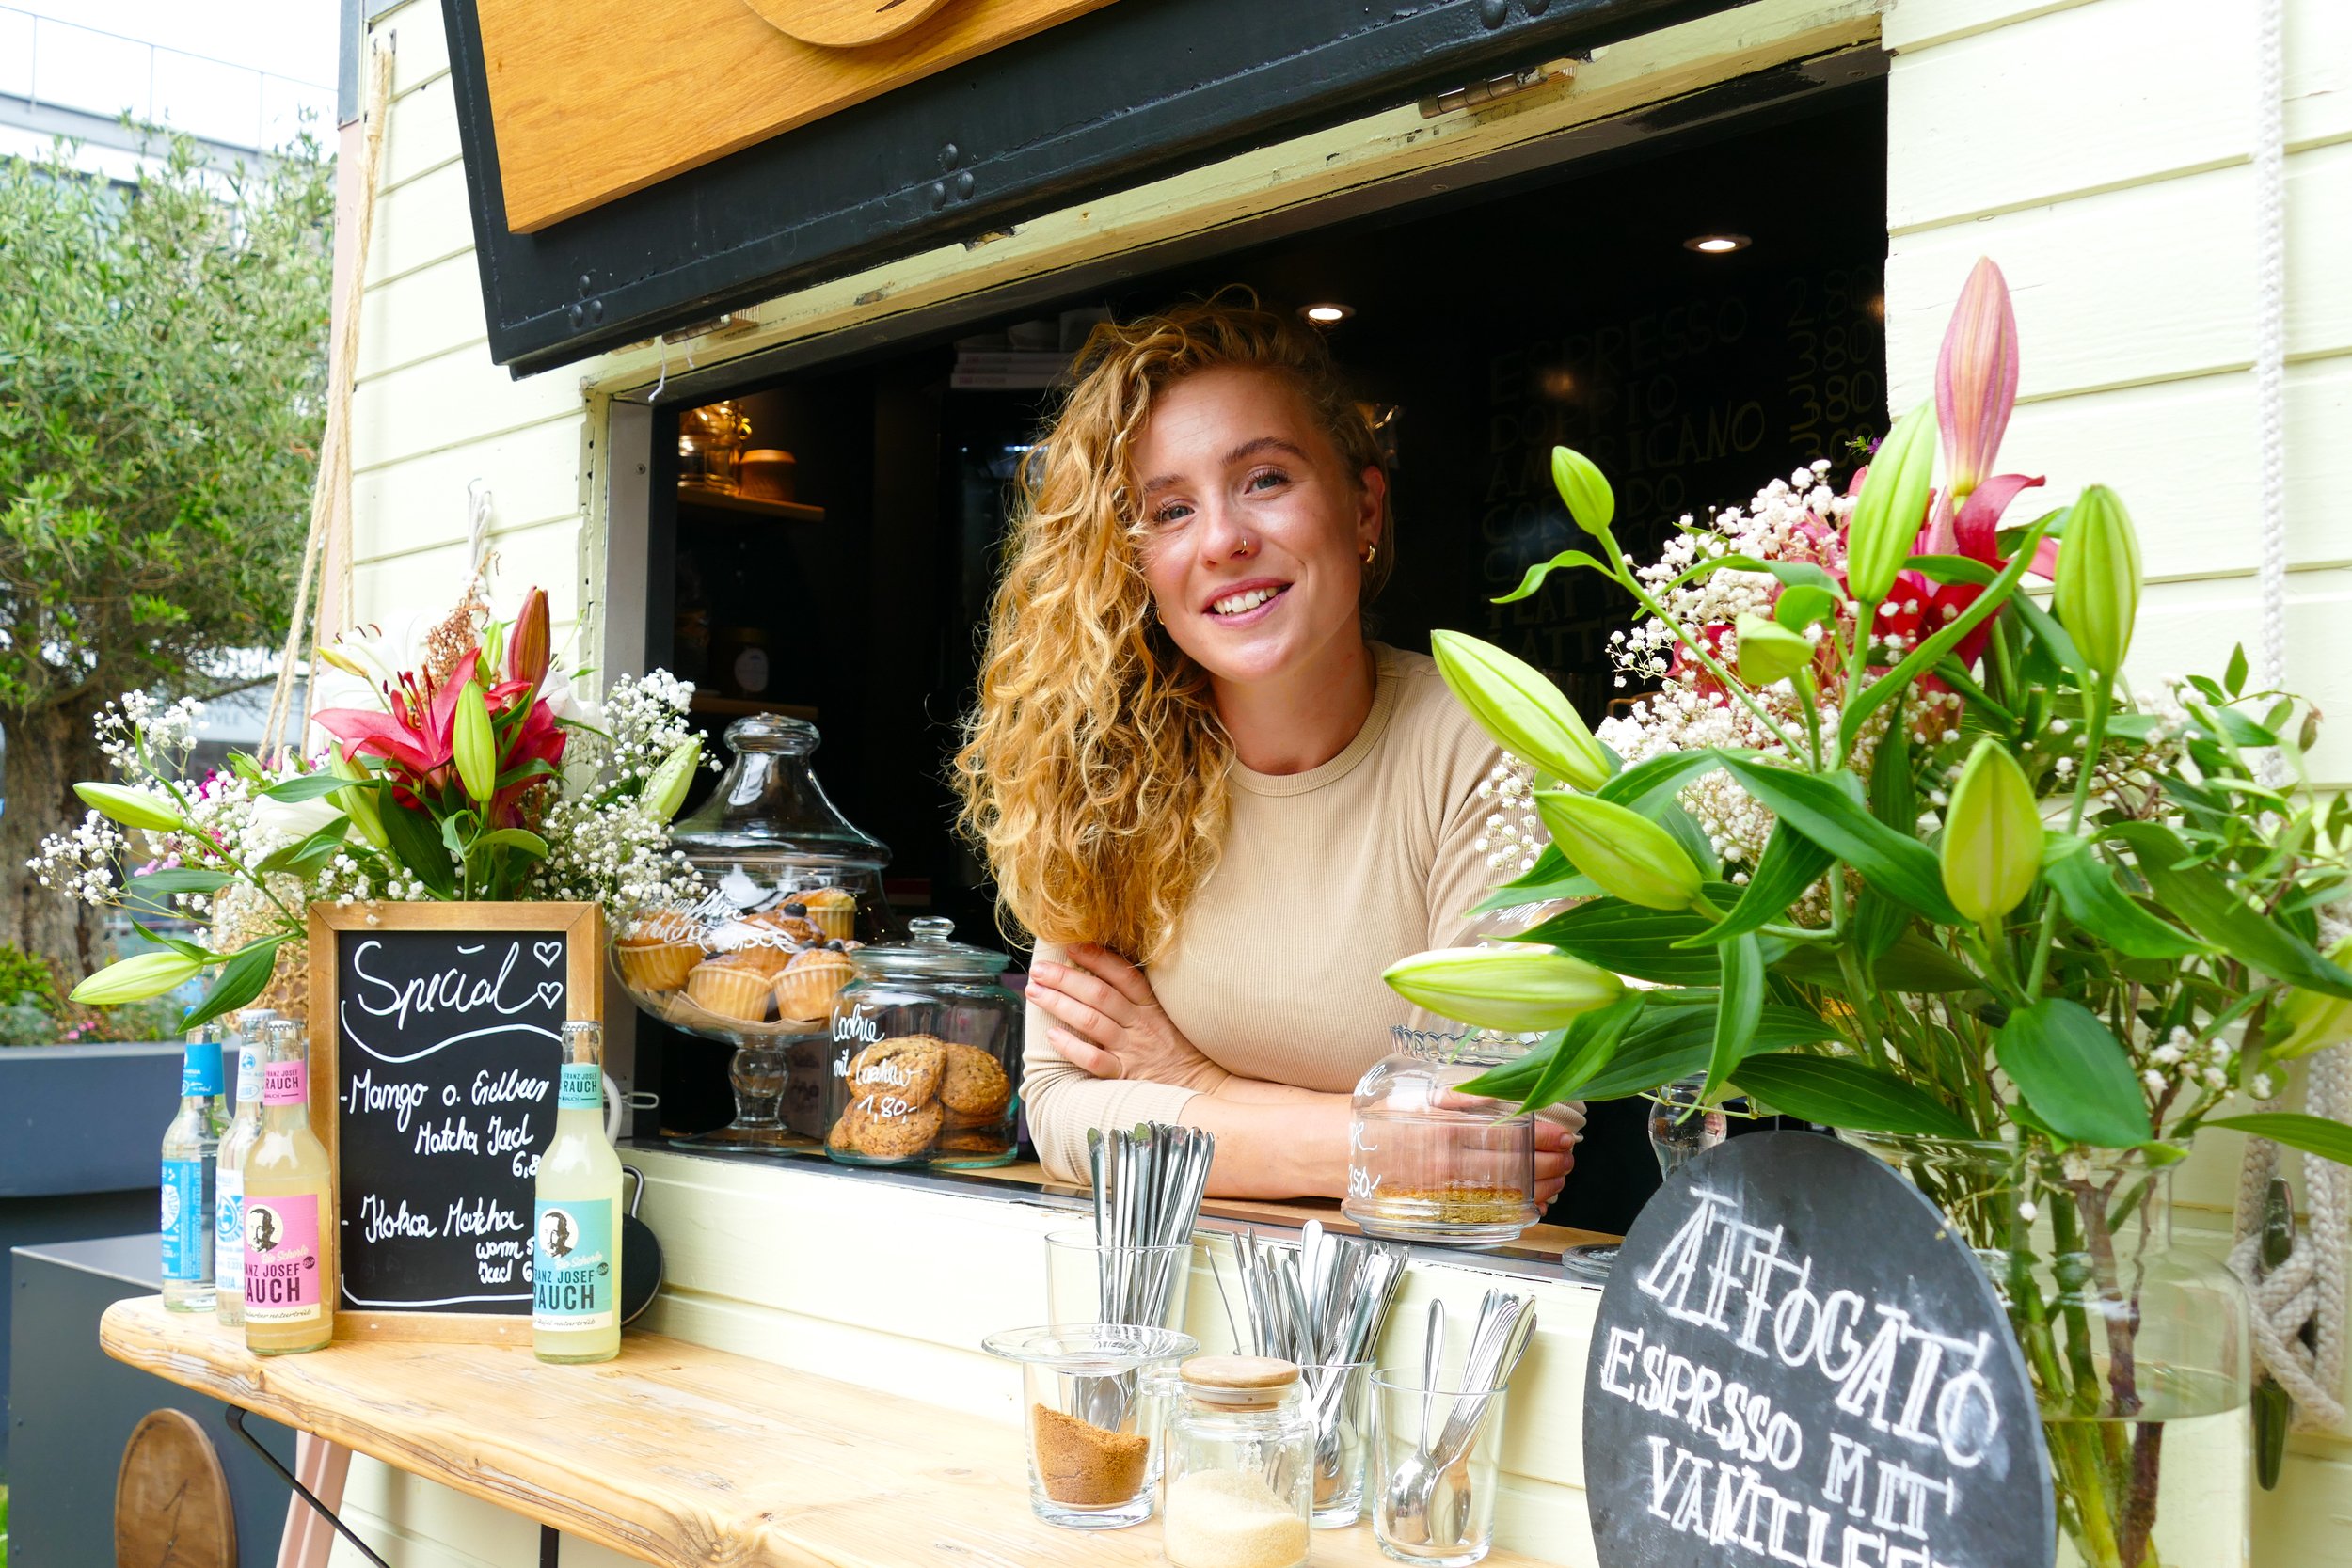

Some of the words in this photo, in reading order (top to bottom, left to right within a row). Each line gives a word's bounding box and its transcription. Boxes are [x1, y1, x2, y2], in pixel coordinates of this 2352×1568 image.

[1483, 399, 1766, 503] AMRICANO
[1481, 473, 1685, 544] CORDO
[354, 941, 539, 1030] Special
[833, 1003, 885, 1042] Cookie
[265, 1077, 299, 1090] RAUCH
[564, 1081, 597, 1093] RAUCH
[414, 1116, 479, 1156] Matcha
[512, 1150, 541, 1179] 6,8
[442, 1197, 525, 1237] Matcha
[263, 1263, 300, 1277] JOSEF
[558, 1270, 594, 1284] JOSEF
[245, 1277, 300, 1304] AUCH
[1637, 1186, 1999, 1468] AFFOGATO
[1821, 1432, 1955, 1540] MIT
